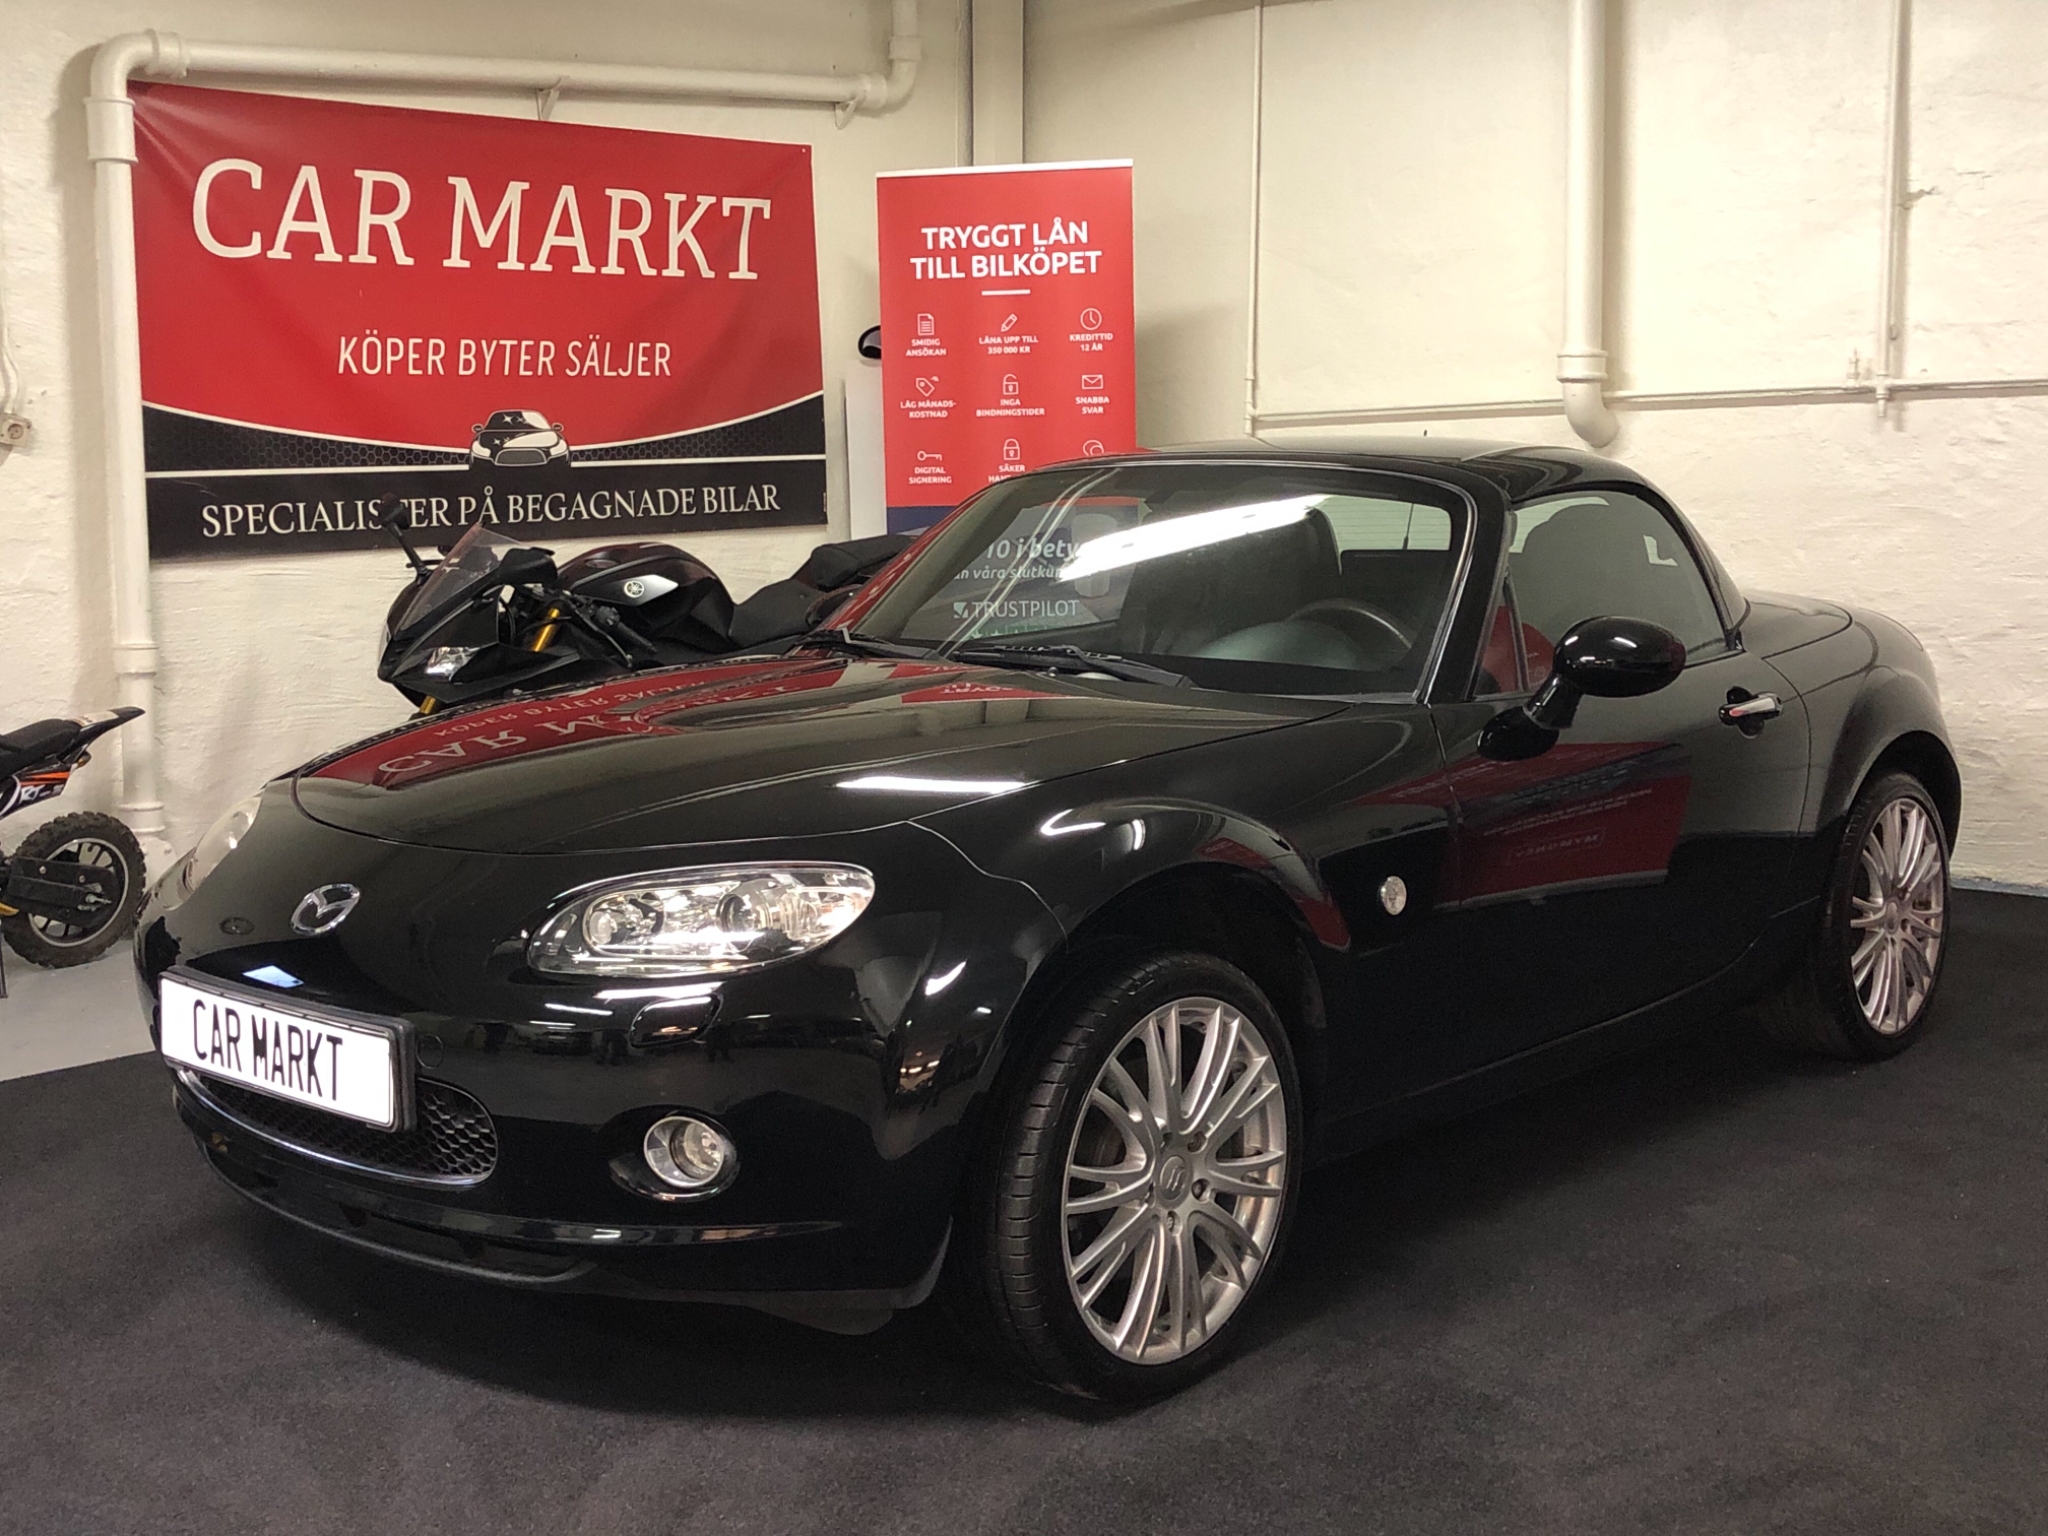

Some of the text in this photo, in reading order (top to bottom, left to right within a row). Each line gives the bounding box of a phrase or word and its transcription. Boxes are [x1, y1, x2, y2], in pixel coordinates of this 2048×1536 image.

[193, 158, 771, 280] CAR MARKT
[921, 216, 1088, 250] TRYGGT LÅN
[910, 246, 1102, 280] TILL BILKÖPET
[979, 335, 1039, 345] LÅNA UPP TILL
[1069, 332, 1114, 342] KREDITTID
[911, 338, 941, 347] SMIDIG
[1080, 342, 1104, 352] 12 ÅR
[338, 329, 671, 378] KÖPER BYTER SÄLJER
[905, 347, 947, 357] ANSÖKAN
[1003, 346, 1018, 355] 000
[1019, 345, 1031, 354] KR
[900, 399, 917, 409] LÅG
[1000, 398, 1021, 407] INGA
[1075, 396, 1109, 405] SNABBA
[909, 410, 948, 419] KOSTNAD
[976, 407, 1045, 417] BINDNINGSTIDER
[1082, 405, 1104, 414] SVAR
[914, 465, 946, 475] DIGITAL
[998, 463, 1025, 473] SÄKER
[908, 475, 952, 484] SIGNERING
[202, 495, 453, 538] SPECIALISER
[457, 485, 500, 527] PÅ
[507, 488, 697, 524] BEGAGNADE
[702, 483, 780, 515] BILAR
[1029, 537, 1081, 561] bety
[973, 565, 1006, 580] våra
[971, 599, 1080, 618] TRUSTPILOT
[193, 999, 343, 1102] CAR MARKT
